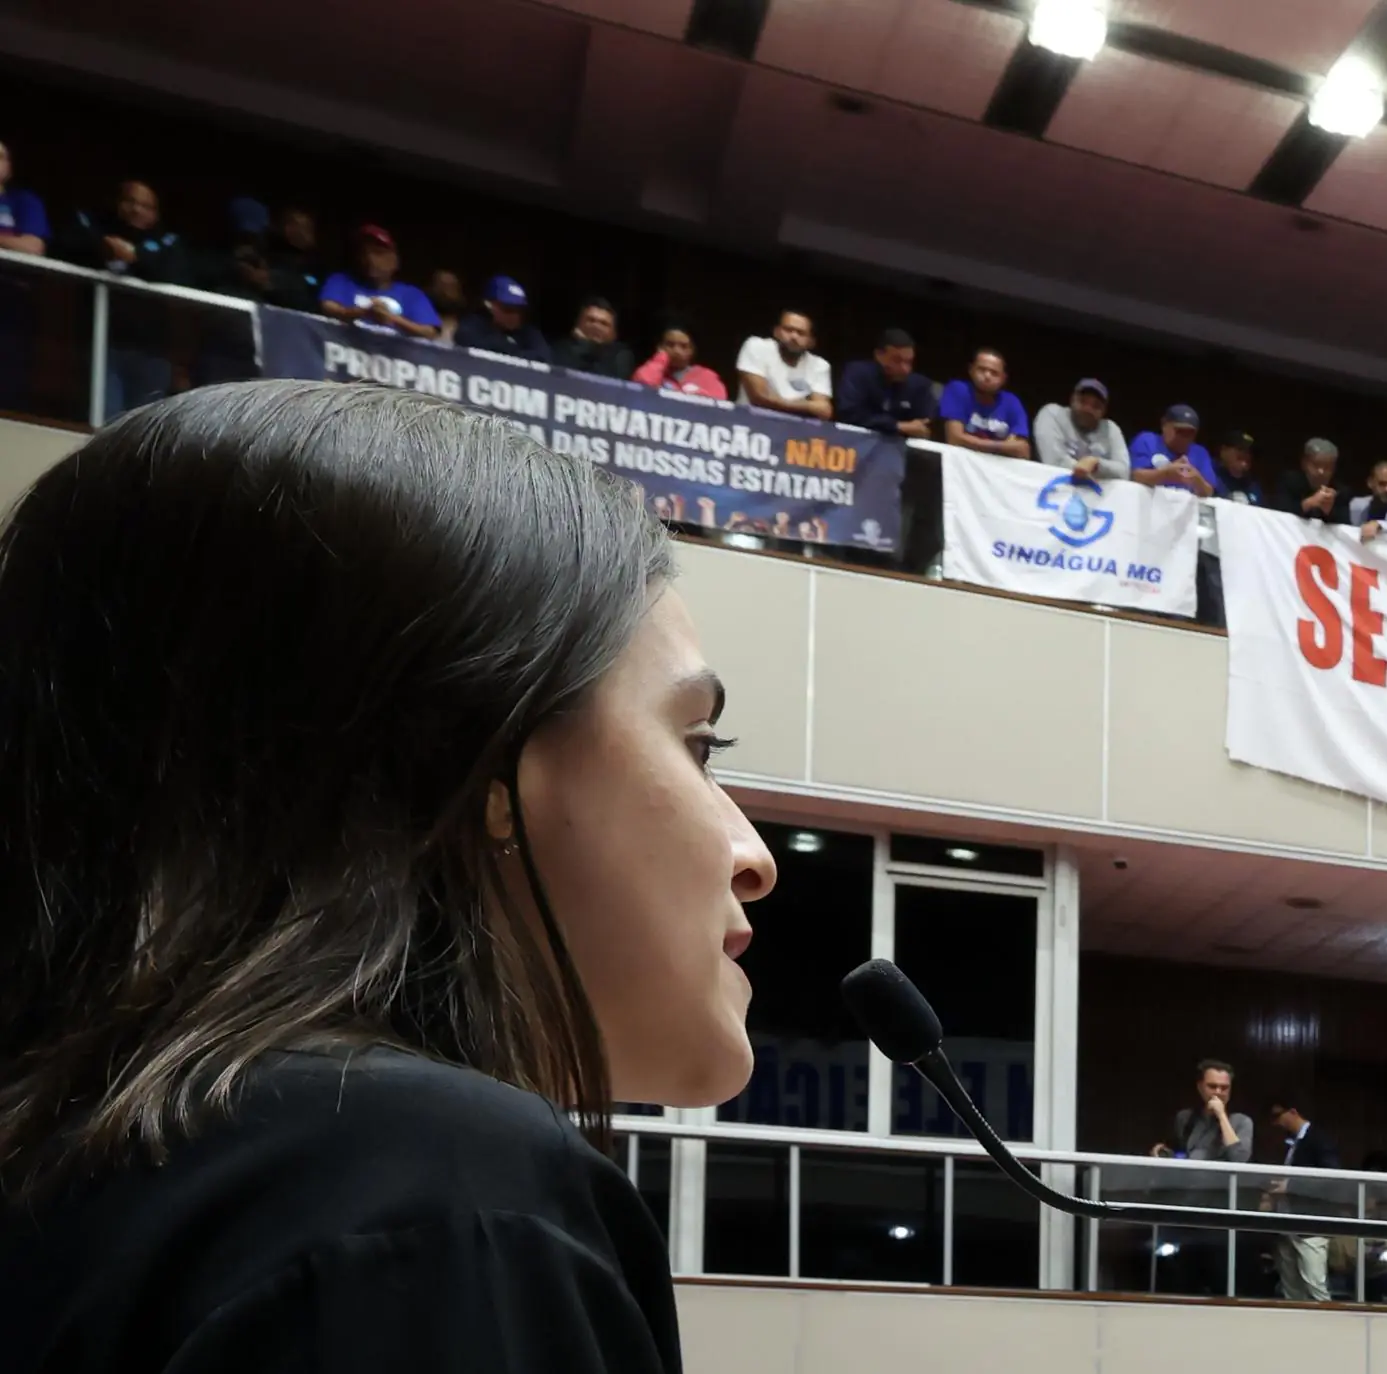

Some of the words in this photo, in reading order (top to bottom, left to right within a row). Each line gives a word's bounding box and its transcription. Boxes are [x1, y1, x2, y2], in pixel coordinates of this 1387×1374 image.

[324, 341, 462, 400] PROPAG
[468, 375, 548, 420] COM
[554, 393, 780, 466] PRIVATIZAÇÃO,
[786, 436, 857, 473] NÃO!
[552, 430, 610, 464] DAS
[614, 441, 726, 486] NOSSAS
[729, 463, 855, 506] ESTATAIS!
[991, 541, 1118, 576] SINDÁGUA
[1127, 563, 1163, 585] MG
